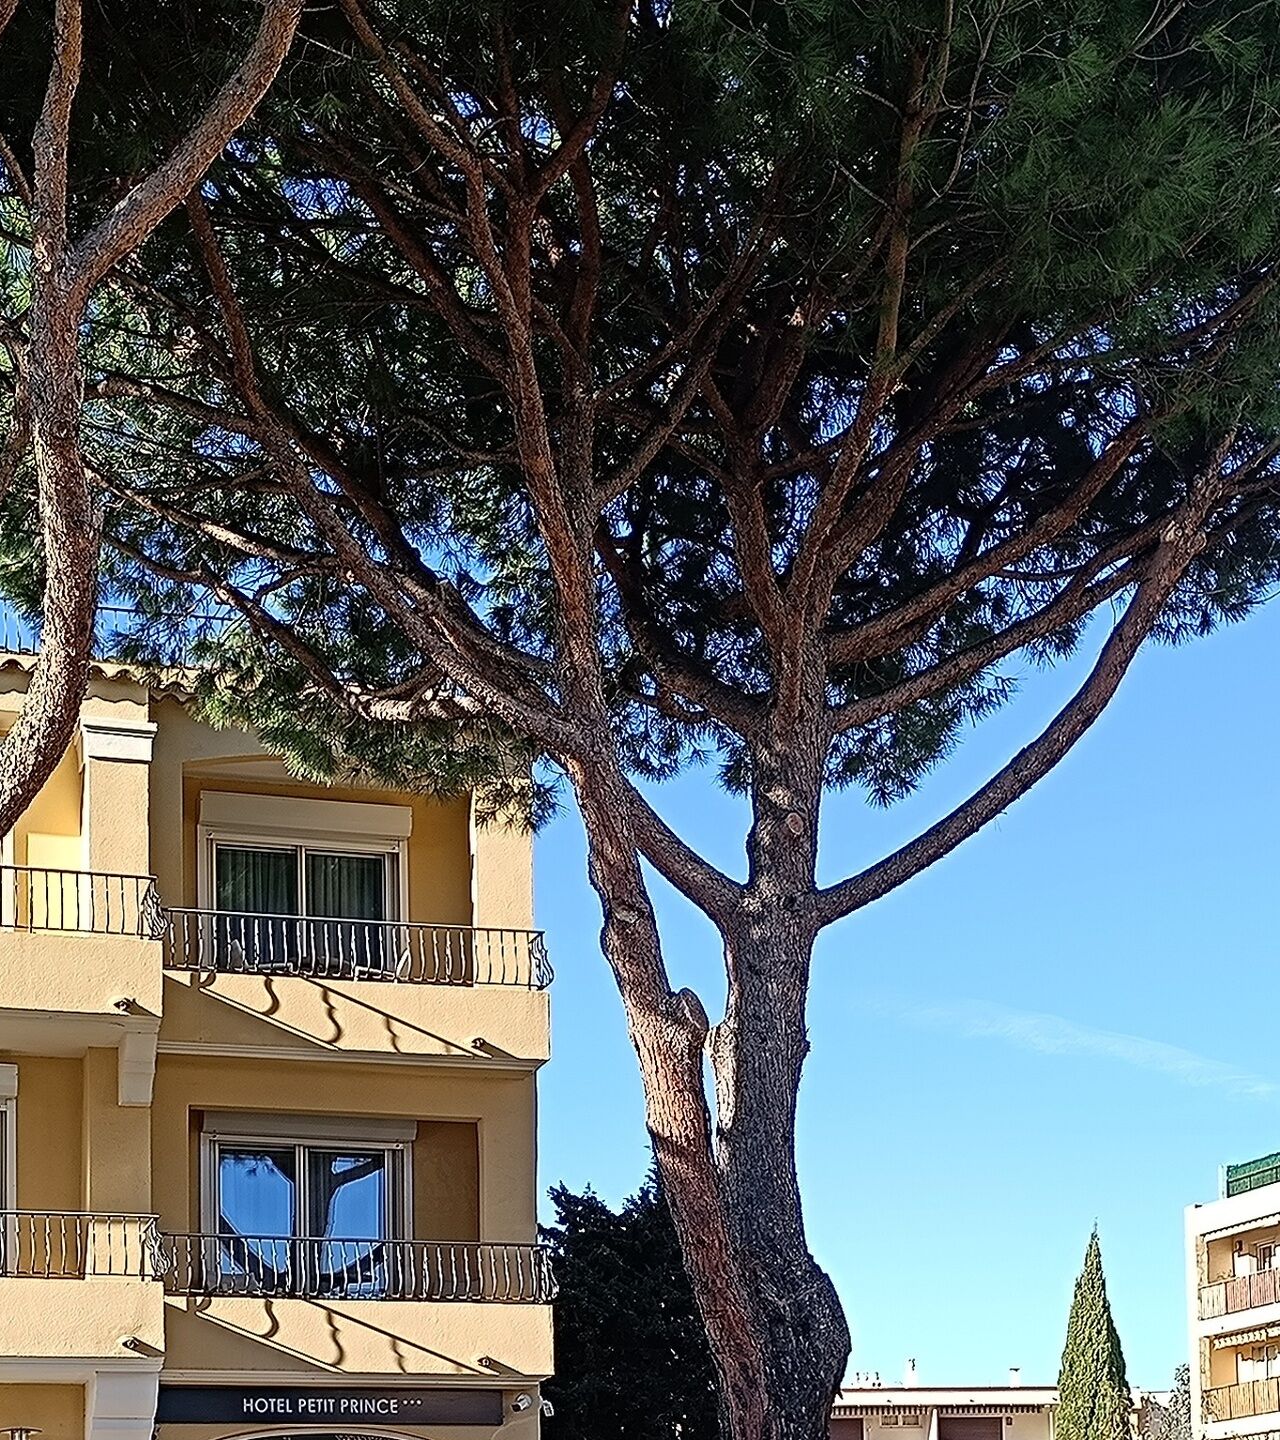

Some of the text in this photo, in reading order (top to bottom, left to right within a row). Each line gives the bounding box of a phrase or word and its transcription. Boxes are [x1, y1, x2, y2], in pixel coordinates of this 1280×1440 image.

[243, 1398, 399, 1414] HOTEL PETIT PRINCE
